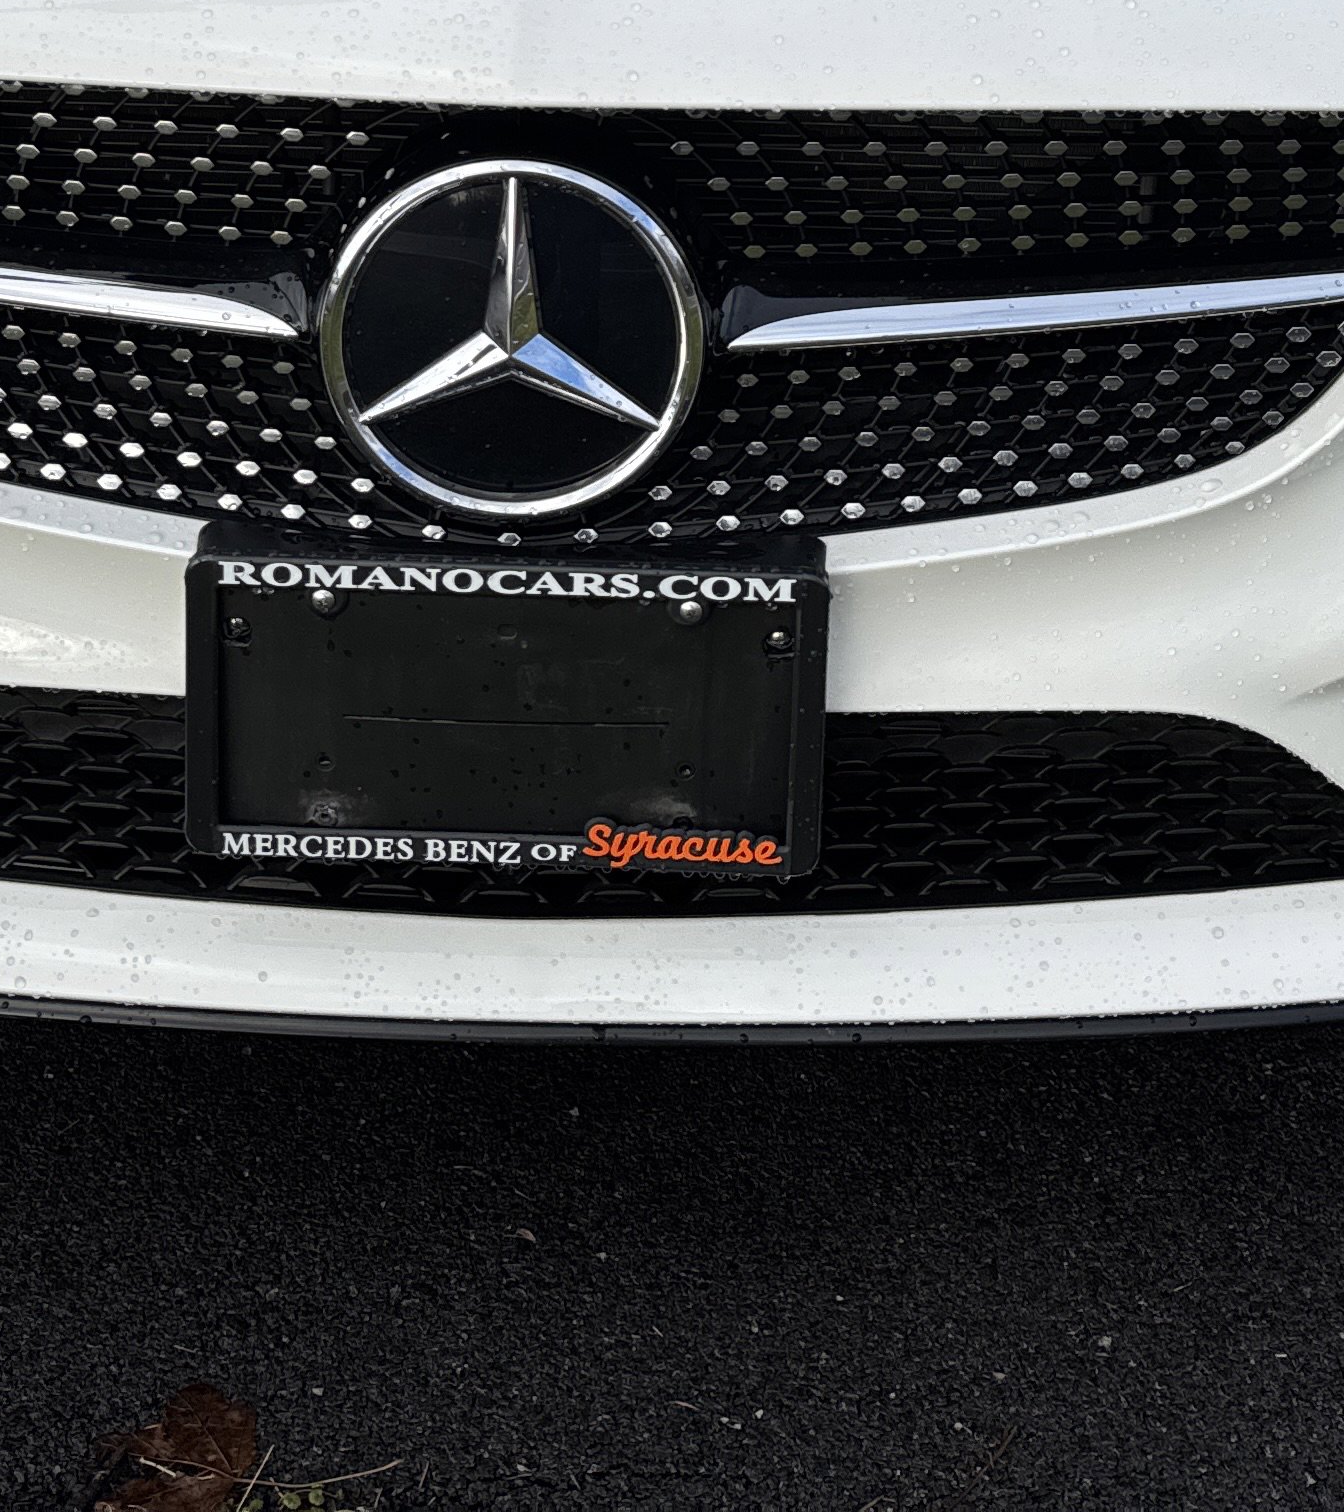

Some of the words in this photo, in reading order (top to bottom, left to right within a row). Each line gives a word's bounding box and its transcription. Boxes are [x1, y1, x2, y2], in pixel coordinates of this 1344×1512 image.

[218, 560, 797, 603] ROMANOCARS.COM
[221, 832, 415, 861] MERCEDES
[424, 838, 522, 864] BENZ
[530, 843, 576, 862] OF
[582, 823, 783, 868] Syracuse
